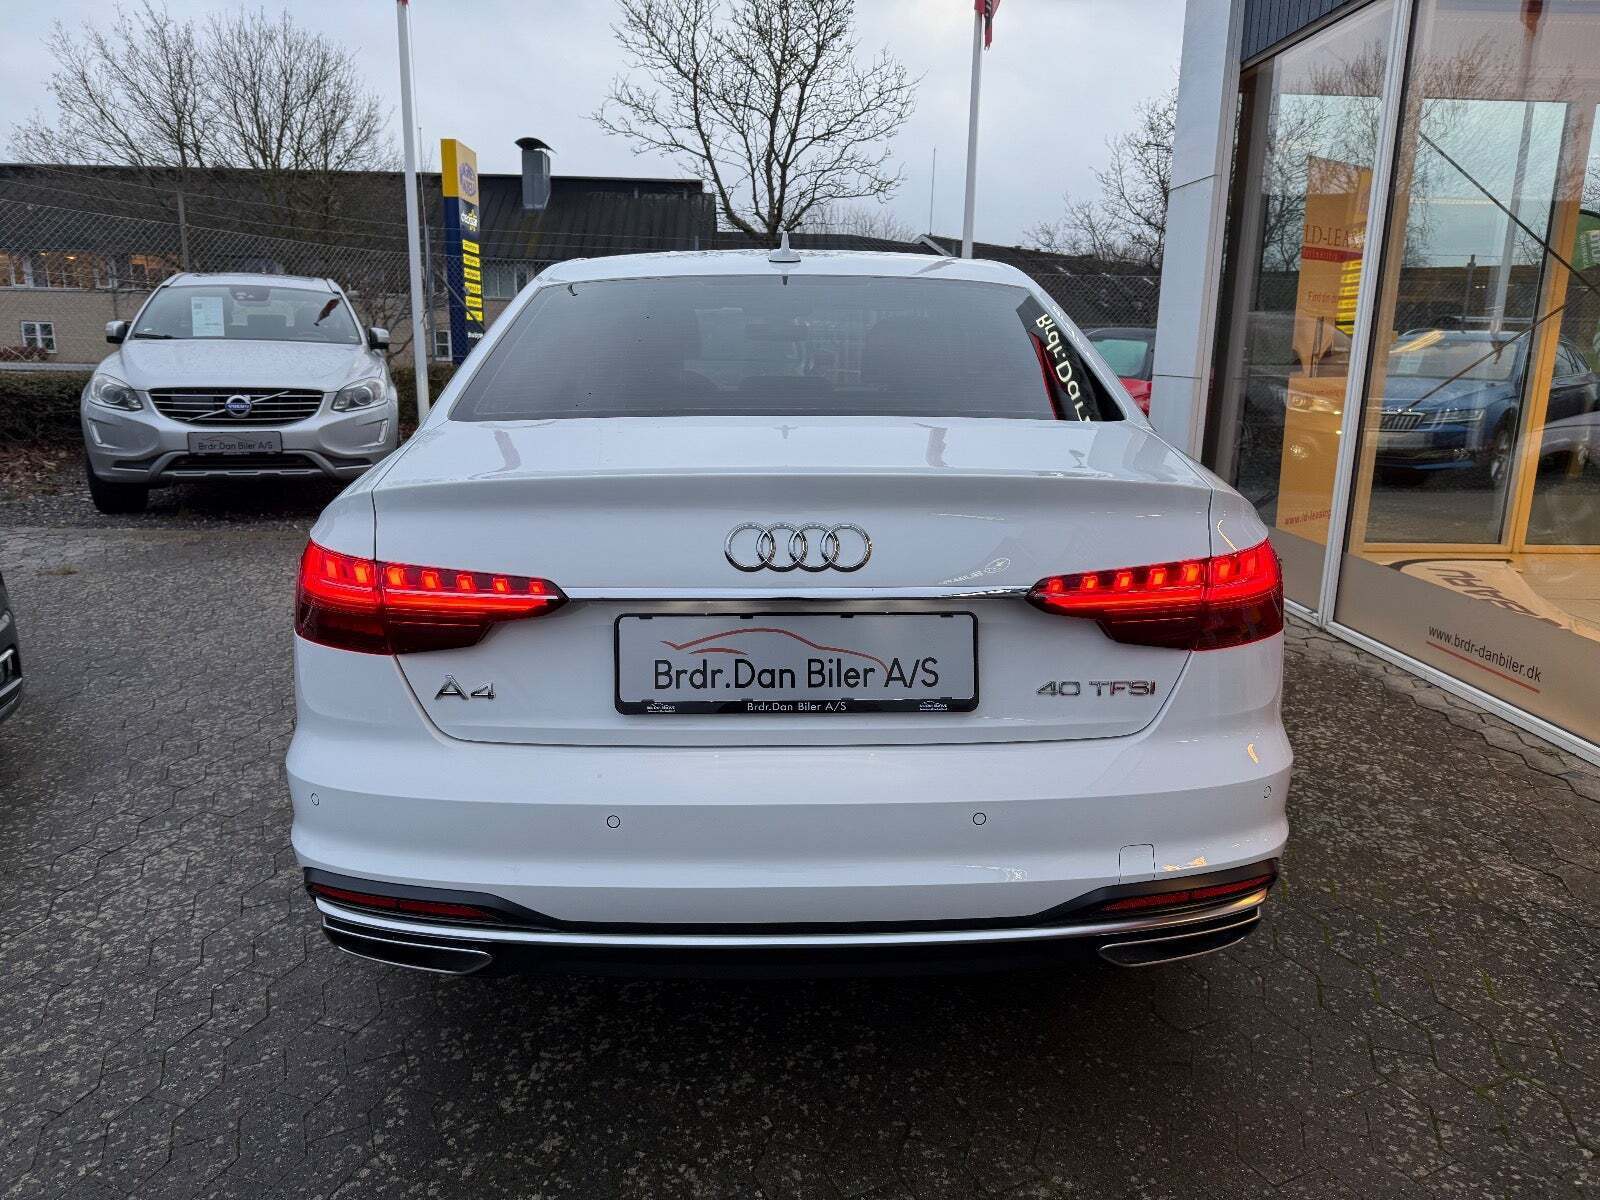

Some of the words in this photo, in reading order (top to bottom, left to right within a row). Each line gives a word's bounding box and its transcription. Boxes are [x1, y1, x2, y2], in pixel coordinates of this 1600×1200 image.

[1428, 625, 1543, 682] www.brdr-danbiler.dk
[654, 658, 796, 690] Brdr.Dan
[808, 657, 875, 689] Biler
[884, 657, 939, 688] A/S
[434, 674, 497, 701] A4
[1036, 681, 1080, 697] 40
[1089, 680, 1156, 697] TFSI
[747, 702, 793, 712] Brdr.Dan
[798, 702, 822, 711] Biler
[825, 701, 847, 712] A/S
